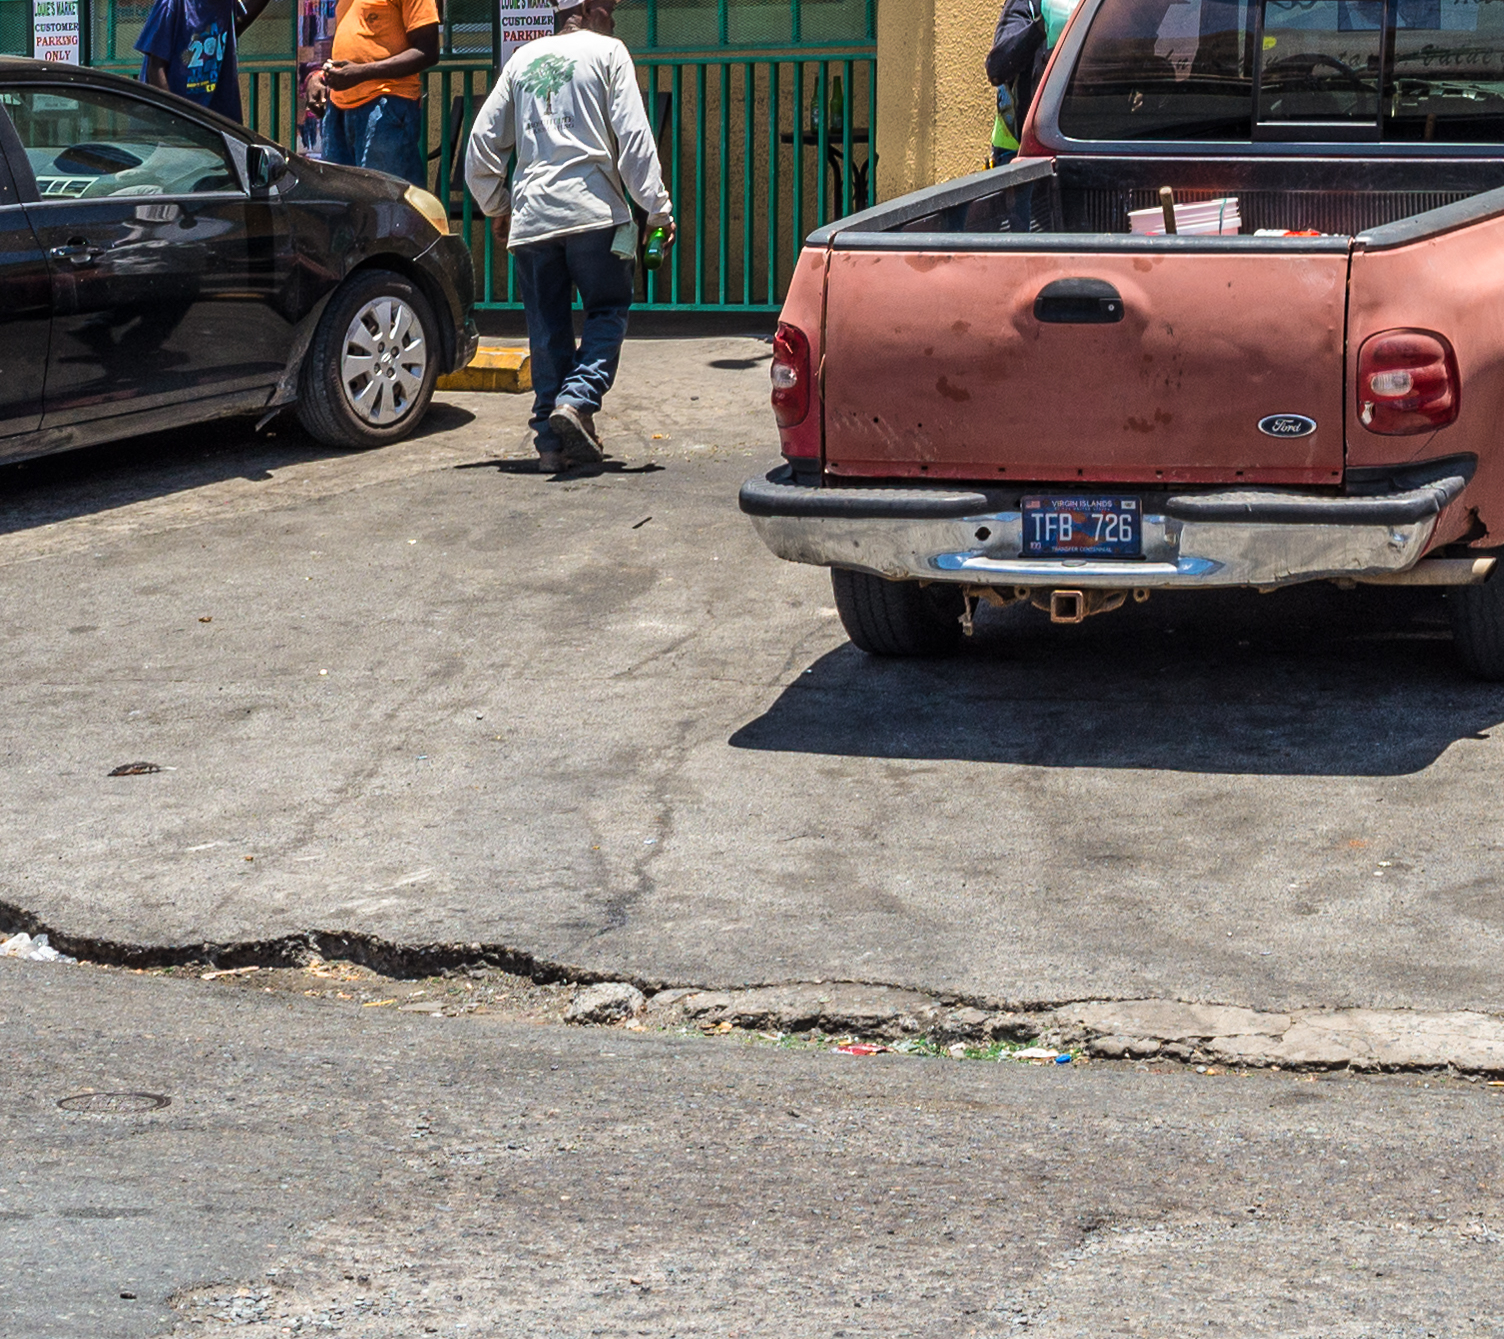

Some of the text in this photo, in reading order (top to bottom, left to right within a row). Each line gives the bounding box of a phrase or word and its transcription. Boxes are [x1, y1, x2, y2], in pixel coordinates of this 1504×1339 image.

[502, 15, 554, 26] CUSTOMER
[35, 23, 79, 33] CUSTOMER
[503, 29, 553, 42] PARKING
[36, 36, 79, 47] PARKING
[45, 51, 71, 61] ONLY
[1271, 418, 1302, 434] Ford
[1051, 500, 1113, 509] VIRGIN ISLANDS
[1031, 513, 1133, 542] TFB 726
